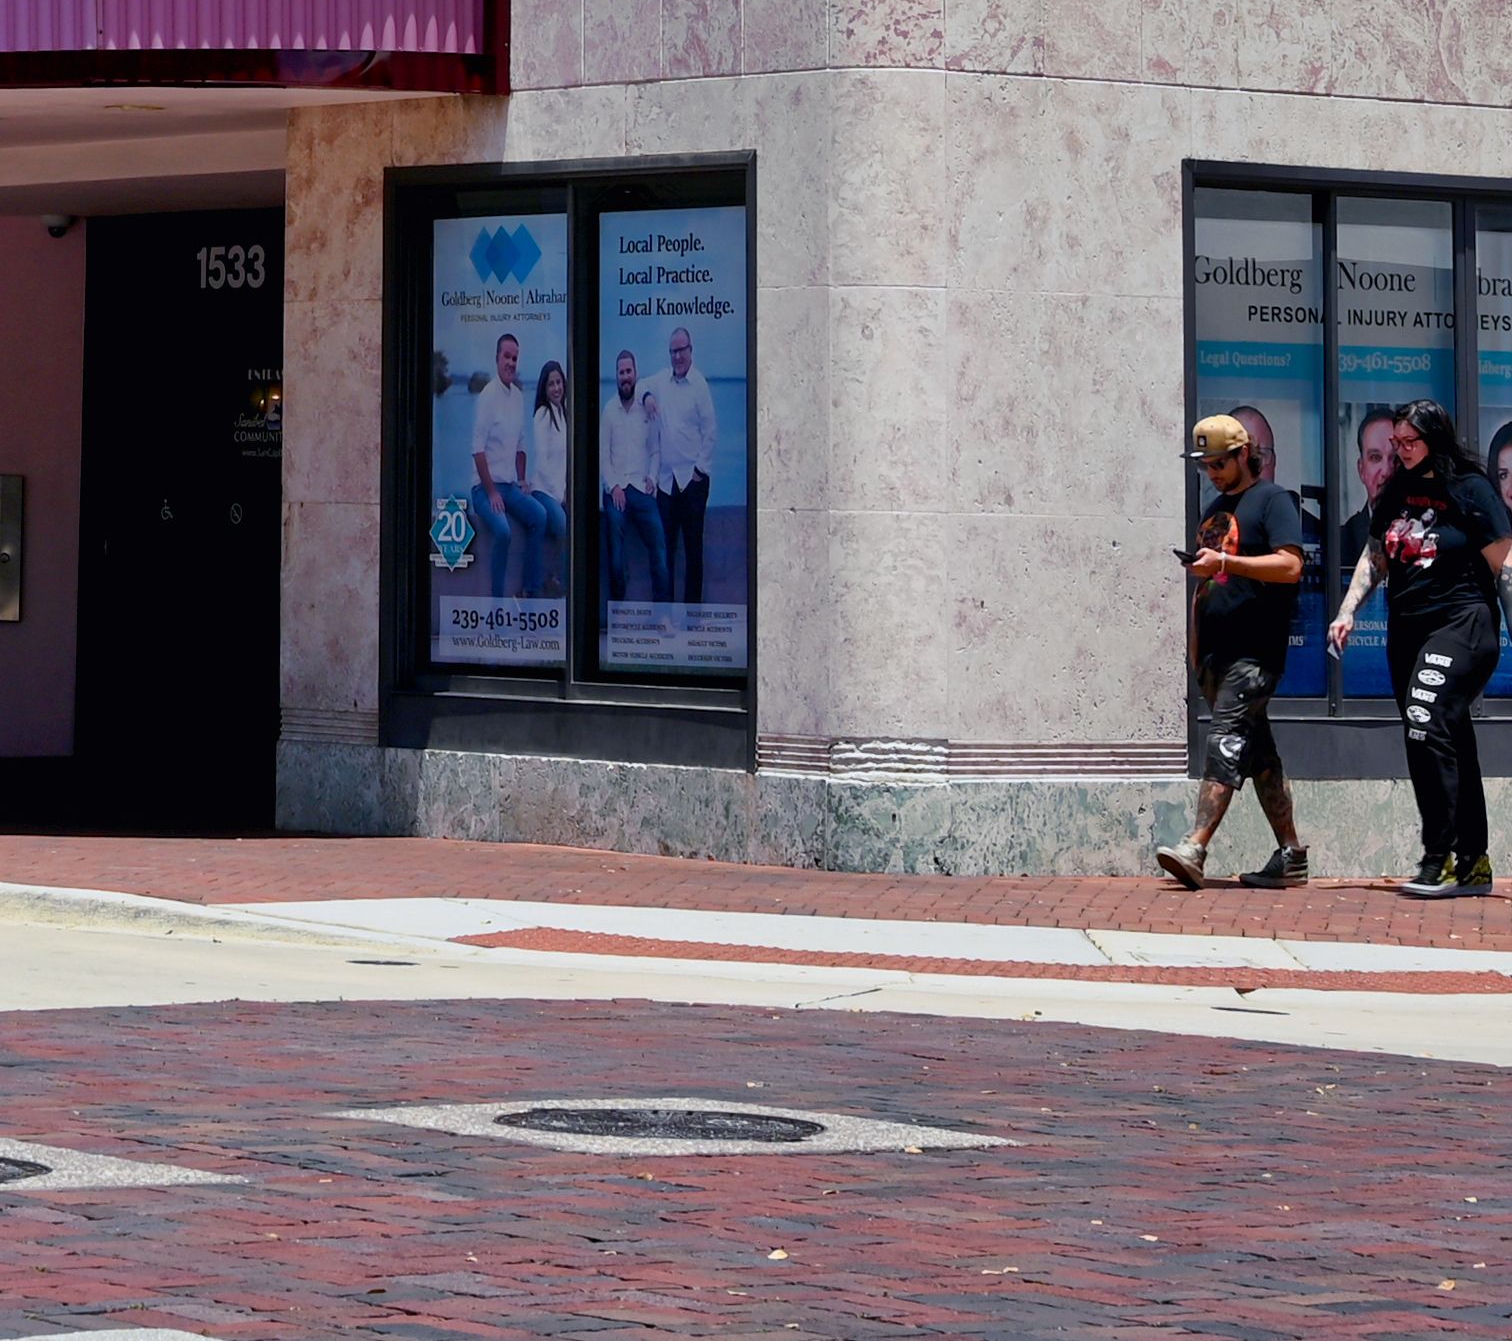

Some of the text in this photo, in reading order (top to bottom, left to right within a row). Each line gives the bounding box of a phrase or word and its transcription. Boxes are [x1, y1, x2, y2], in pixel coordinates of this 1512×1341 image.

[619, 232, 705, 257] Local People.
[196, 244, 266, 290] 1533
[619, 263, 713, 285] Local Practice.
[1194, 255, 1303, 294] Goldberg
[1337, 262, 1416, 293] Noone
[441, 290, 482, 308] Goldberg
[486, 289, 520, 305] Noone
[619, 295, 734, 319] Local Knowledge.
[1347, 309, 1408, 327] INJURY
[1200, 350, 1292, 368] Legal Questions?
[1338, 351, 1432, 374] 39-461-5508
[437, 510, 466, 542] 20
[451, 607, 559, 631] 239-461-5508
[452, 633, 560, 653] www.Goldberg-Law.com
